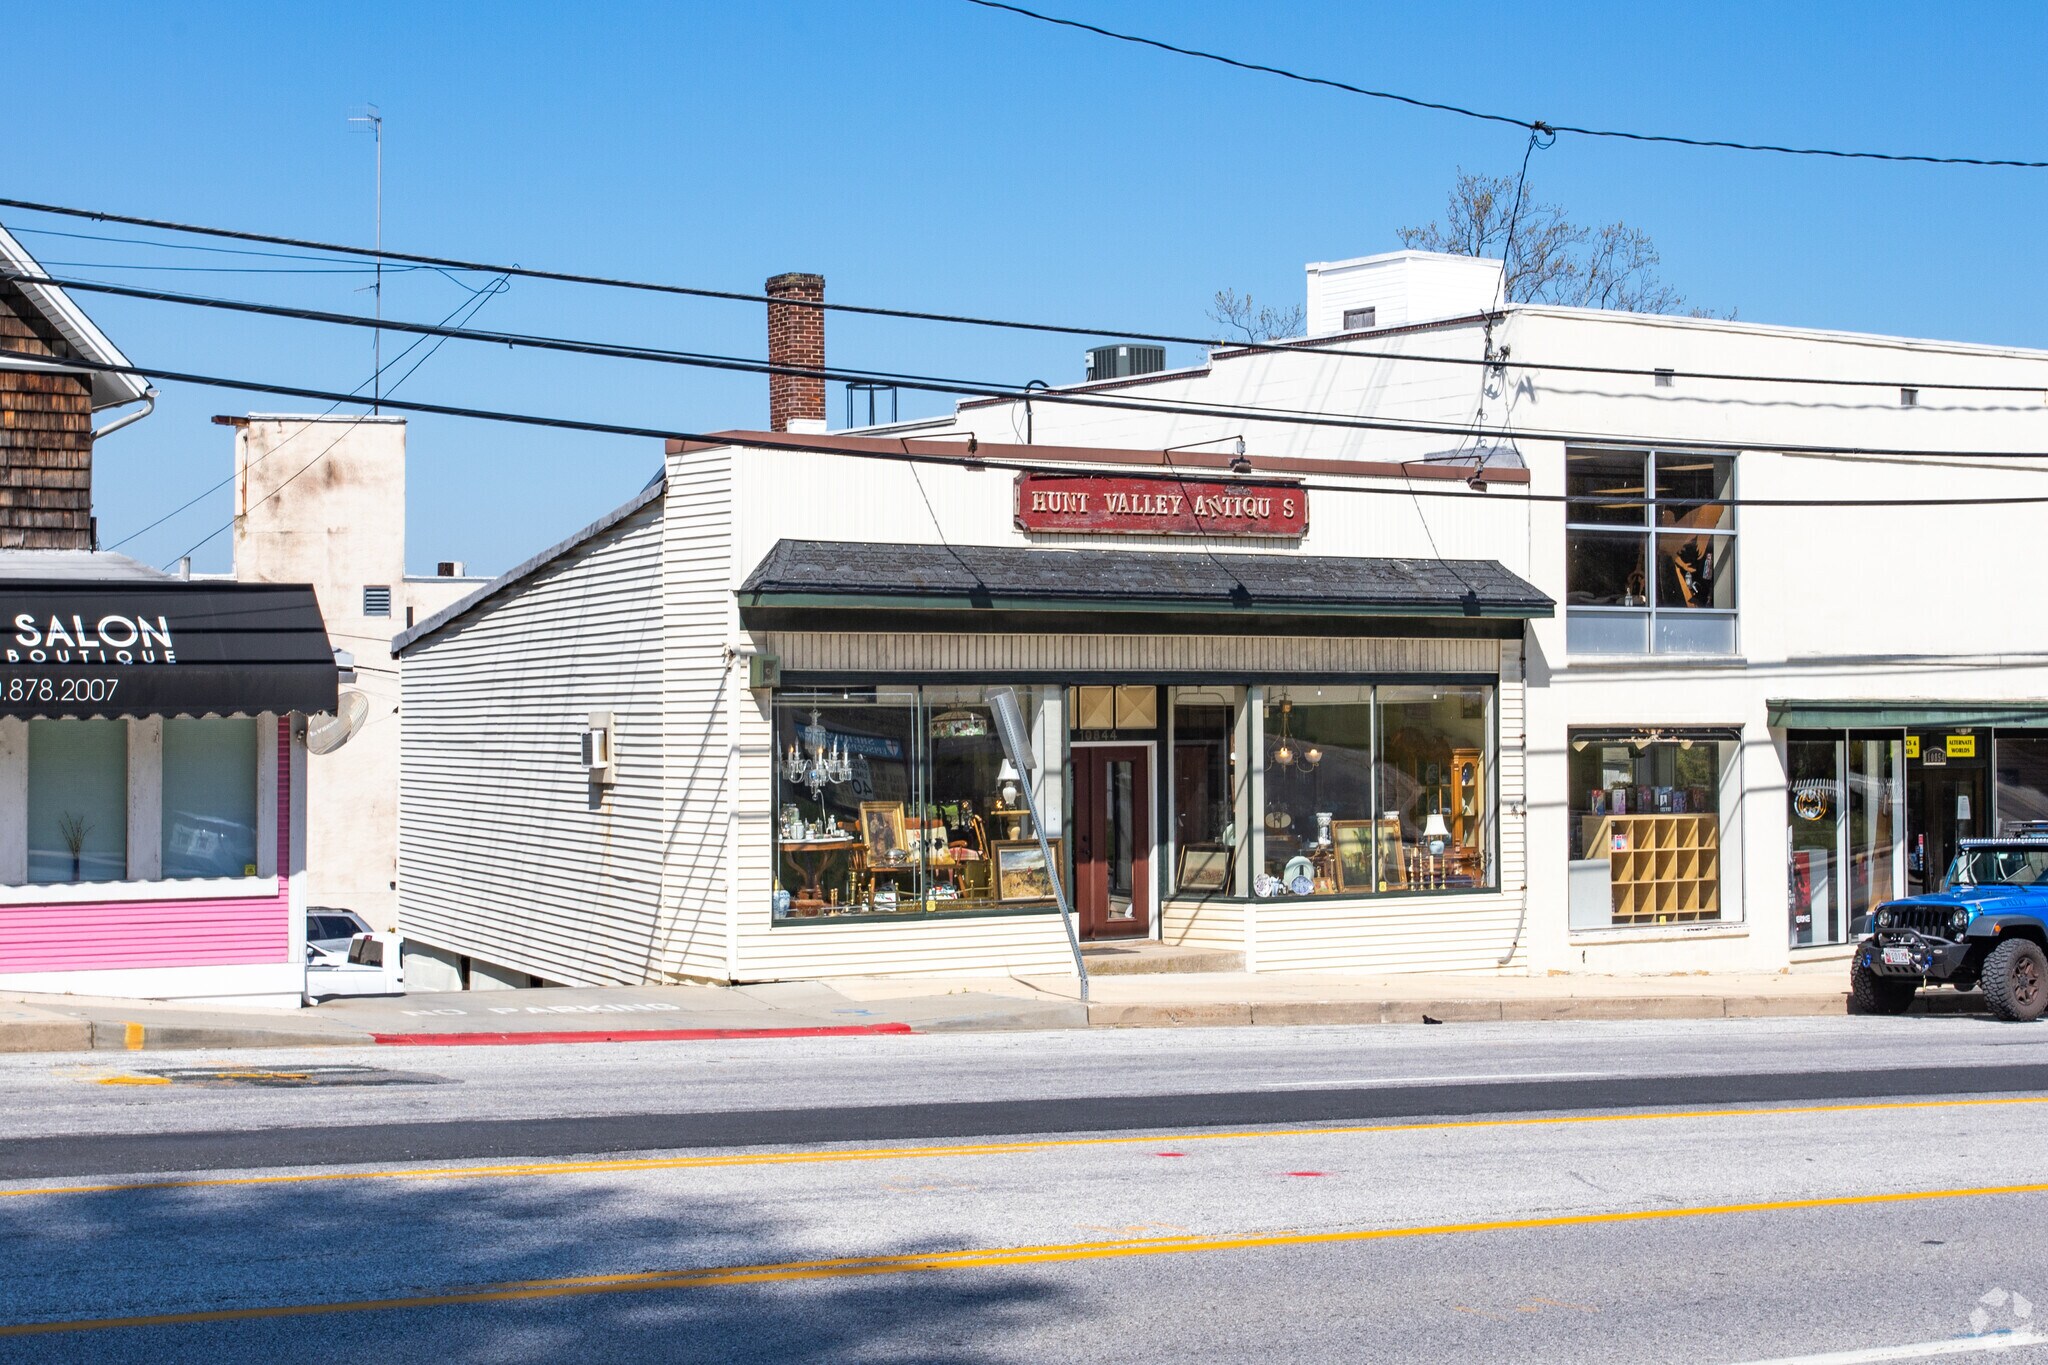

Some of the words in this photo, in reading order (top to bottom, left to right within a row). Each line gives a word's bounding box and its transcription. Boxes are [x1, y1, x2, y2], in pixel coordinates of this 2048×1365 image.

[1031, 491, 1090, 514] HUNT
[1104, 492, 1183, 516] VALLEY
[15, 614, 173, 648] SALON
[7, 649, 177, 665] BOUTIQUE
[0, 678, 119, 701] .878.2007
[1079, 730, 1118, 741] 10844
[401, 1008, 467, 1016] NO
[488, 1003, 680, 1015] PARKING
